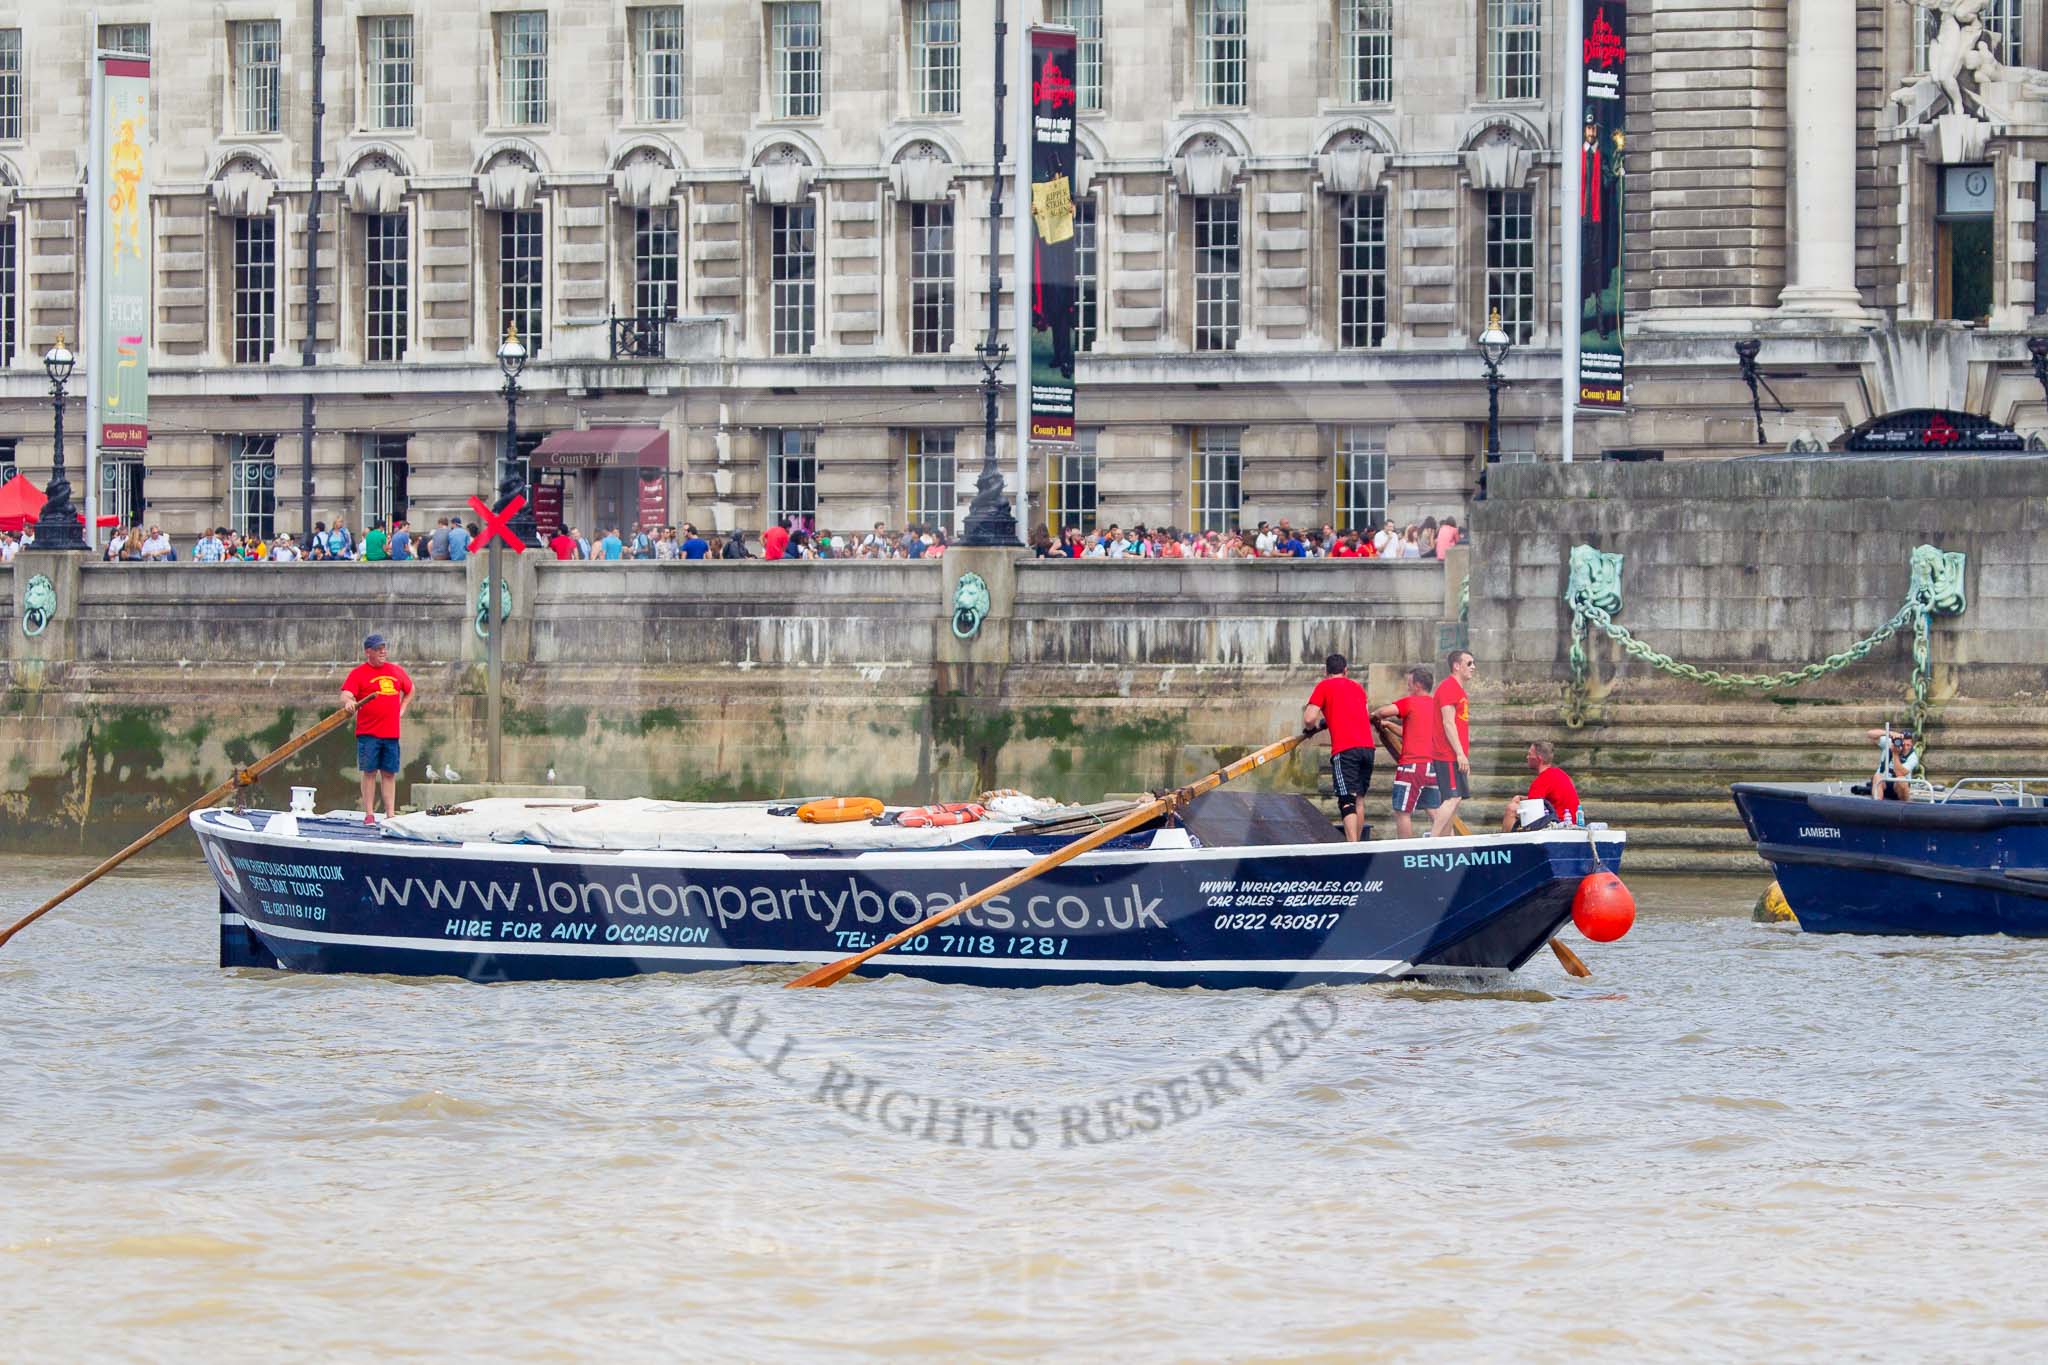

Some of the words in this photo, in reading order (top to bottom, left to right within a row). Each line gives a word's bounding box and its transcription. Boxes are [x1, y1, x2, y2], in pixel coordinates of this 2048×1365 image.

[109, 304, 143, 321] FILM
[1581, 388, 1605, 402] County
[1606, 390, 1621, 401] Hall
[106, 429, 128, 441] County
[129, 429, 142, 440] Hall
[1033, 424, 1056, 437] County
[1058, 425, 1072, 436] Hall
[551, 452, 590, 466] County
[595, 452, 618, 464] Hall
[1799, 827, 1840, 838] LAMBETH
[1403, 850, 1511, 872] BENJAMIN
[249, 875, 271, 892] SPEED
[270, 878, 288, 894] BOAT
[290, 881, 324, 897] TOURS
[366, 868, 1167, 932] www.londonpartyboats.co.uk
[1206, 895, 1233, 907] CAR
[1235, 895, 1274, 906] SALES
[1215, 914, 1267, 930] 01322
[1270, 914, 1339, 930] 430817
[445, 919, 491, 937] HIRE
[500, 921, 541, 938] FOR
[551, 923, 596, 941] ANY
[605, 924, 709, 943] OCCASION
[835, 931, 876, 948] TEL:
[940, 935, 996, 954] 7118
[1006, 937, 1068, 956] 1281
